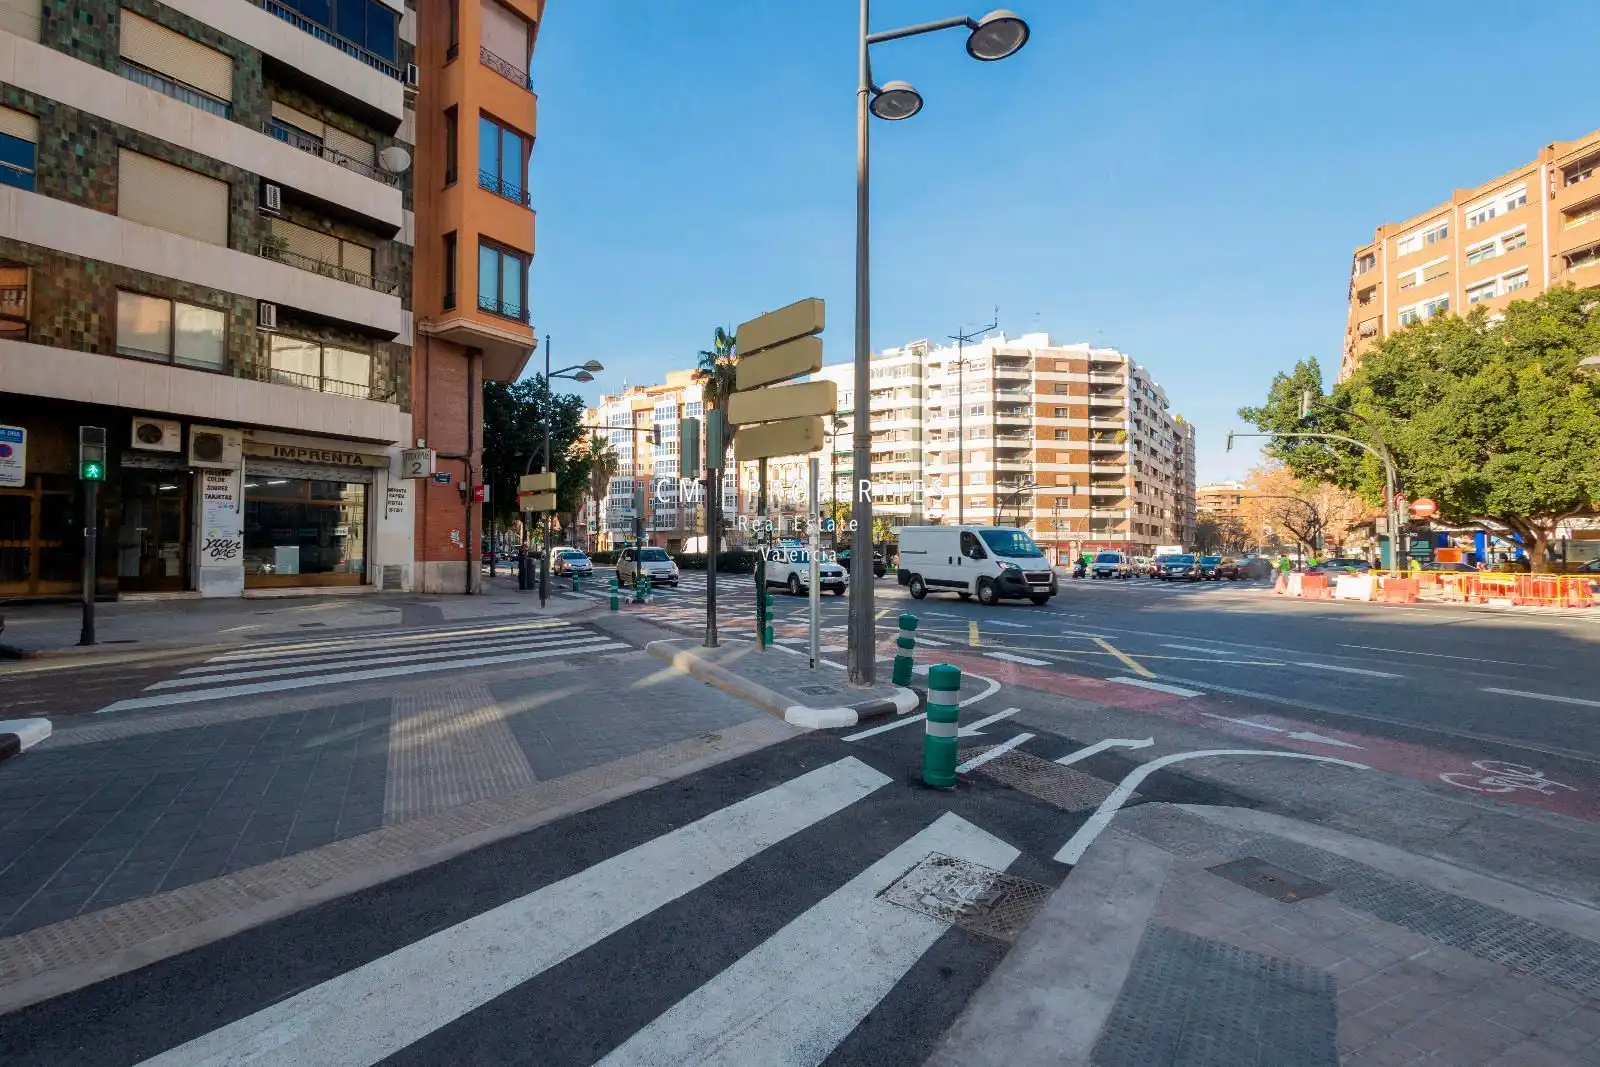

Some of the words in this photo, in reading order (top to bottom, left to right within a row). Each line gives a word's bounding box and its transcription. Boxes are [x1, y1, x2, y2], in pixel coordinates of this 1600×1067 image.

[273, 446, 364, 465] IMPRENTA
[411, 461, 423, 475] 2
[204, 493, 233, 501] TARJETAS
